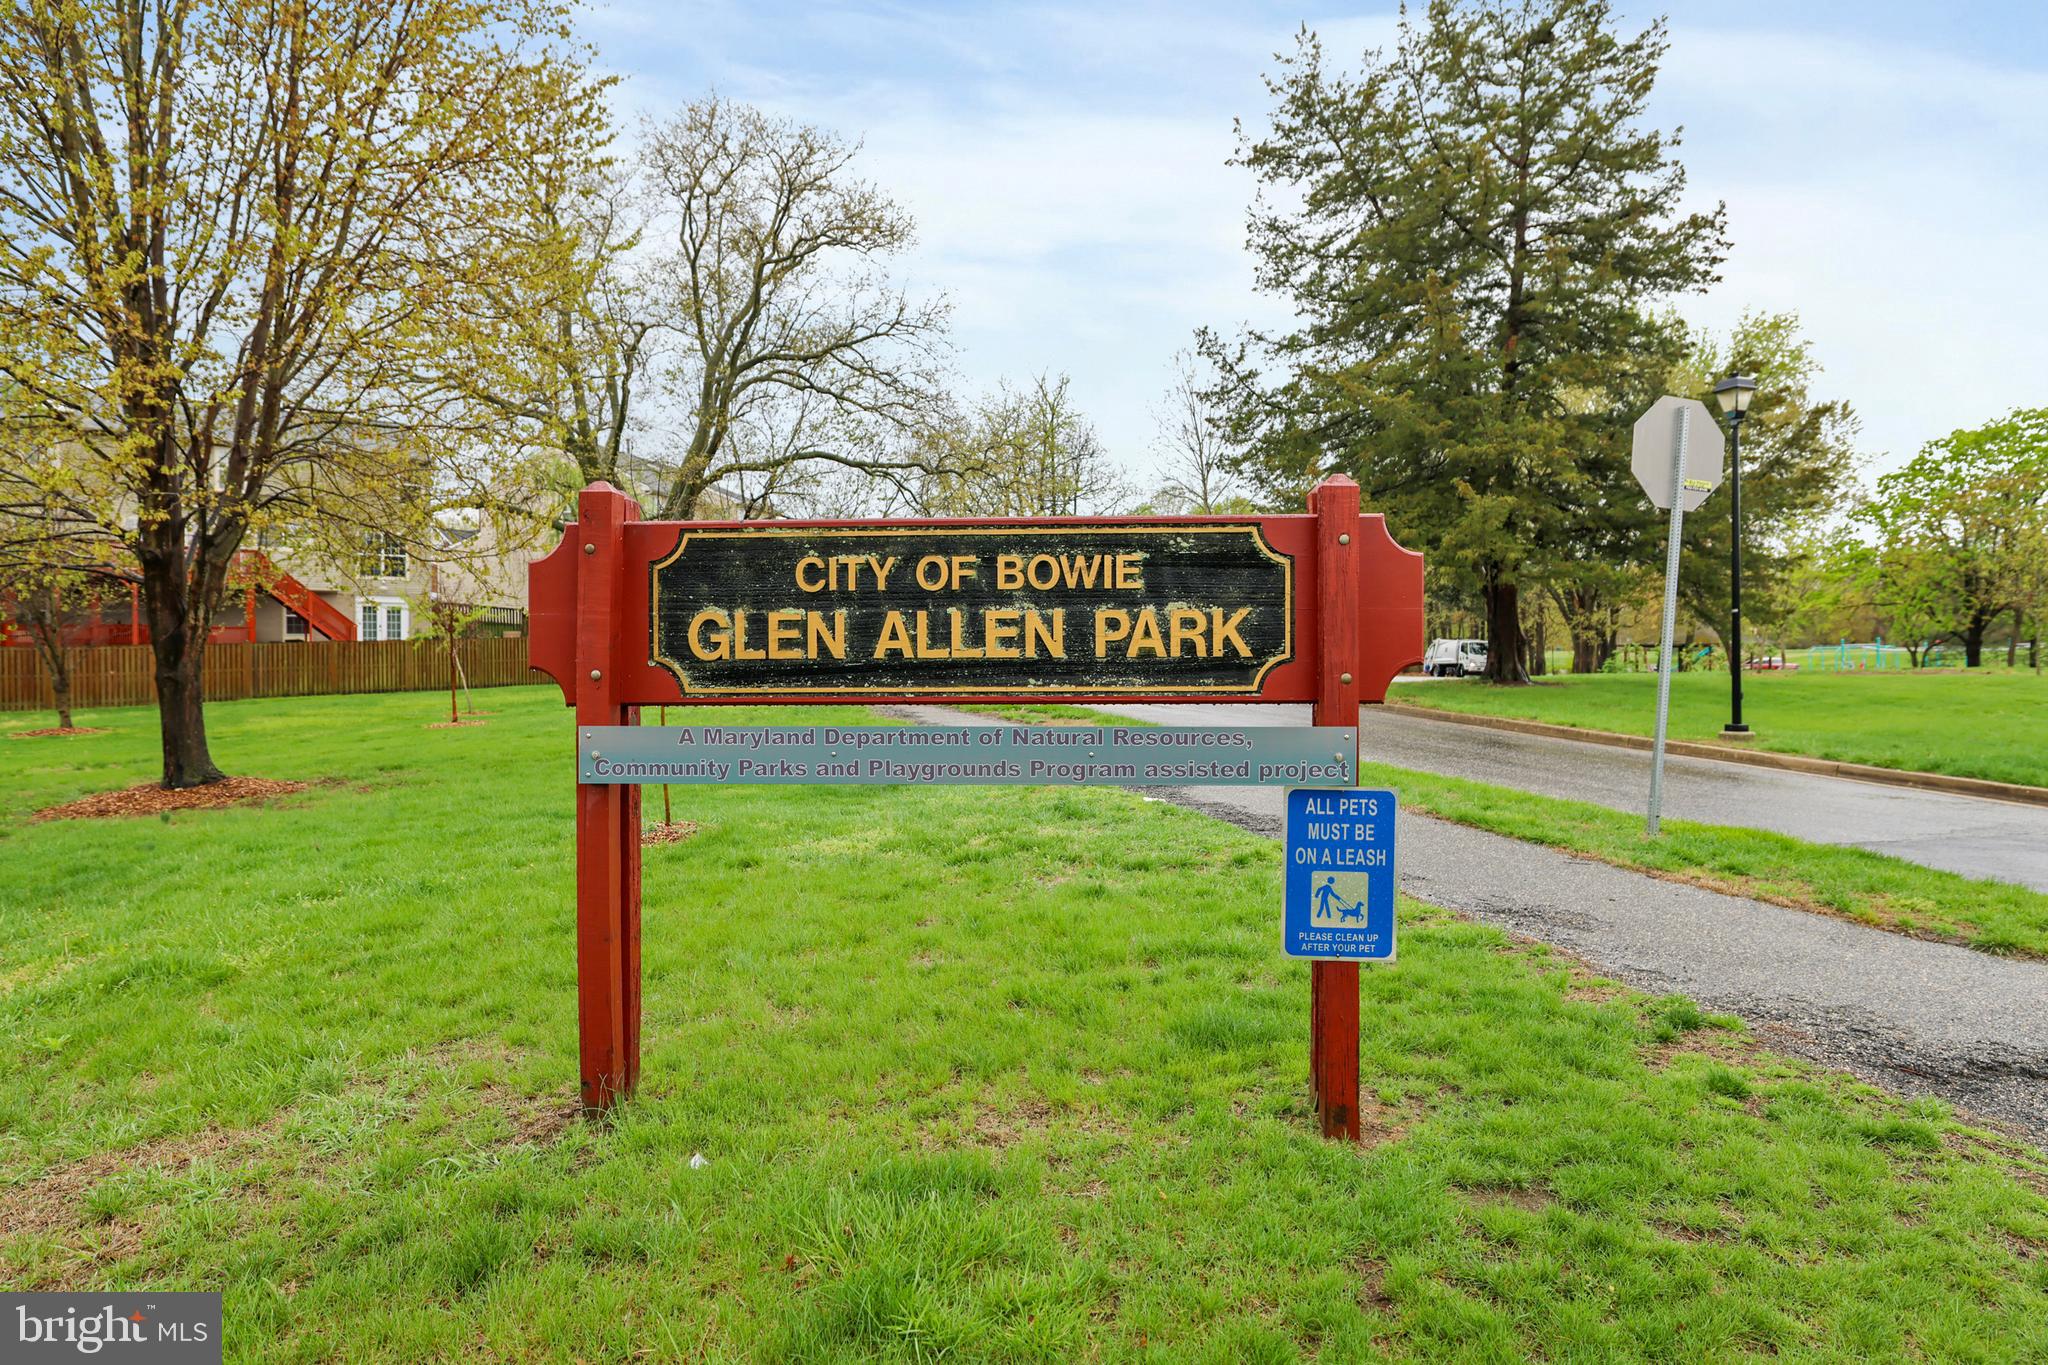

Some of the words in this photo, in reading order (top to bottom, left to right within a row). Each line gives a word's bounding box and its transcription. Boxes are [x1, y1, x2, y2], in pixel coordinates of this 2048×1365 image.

[795, 555, 896, 593] CITY
[915, 554, 979, 592] OF
[996, 552, 1143, 590] BOWIE
[687, 609, 847, 661] GLEN
[873, 608, 1065, 660] ALLEN
[1094, 607, 1254, 658] PARK
[678, 728, 696, 746] A
[703, 728, 816, 750] Maryland
[823, 728, 971, 750] Department
[978, 728, 1003, 746] of
[1012, 728, 1104, 746] Natural
[1113, 728, 1253, 750] Resources,
[594, 759, 731, 781] Community
[738, 759, 808, 777] Parks
[815, 760, 860, 777] and
[868, 759, 1021, 782] Playgrounds
[1029, 760, 1136, 782] Program
[1144, 761, 1250, 778] assisted
[1258, 761, 1350, 783] project
[1305, 798, 1334, 814] ALL
[1339, 799, 1378, 816] PETS
[1308, 823, 1349, 839] MUST
[1354, 824, 1375, 840] BE
[1295, 848, 1316, 864] ON
[1321, 848, 1331, 864] A
[1336, 849, 1386, 866] LEASH
[1298, 932, 1332, 941] PLEASE
[1335, 933, 1363, 942] CLEAN
[1366, 934, 1378, 943] UP
[1301, 943, 1329, 952] AFTER
[1332, 944, 1356, 953] YOUR
[1358, 945, 1375, 953] PET
